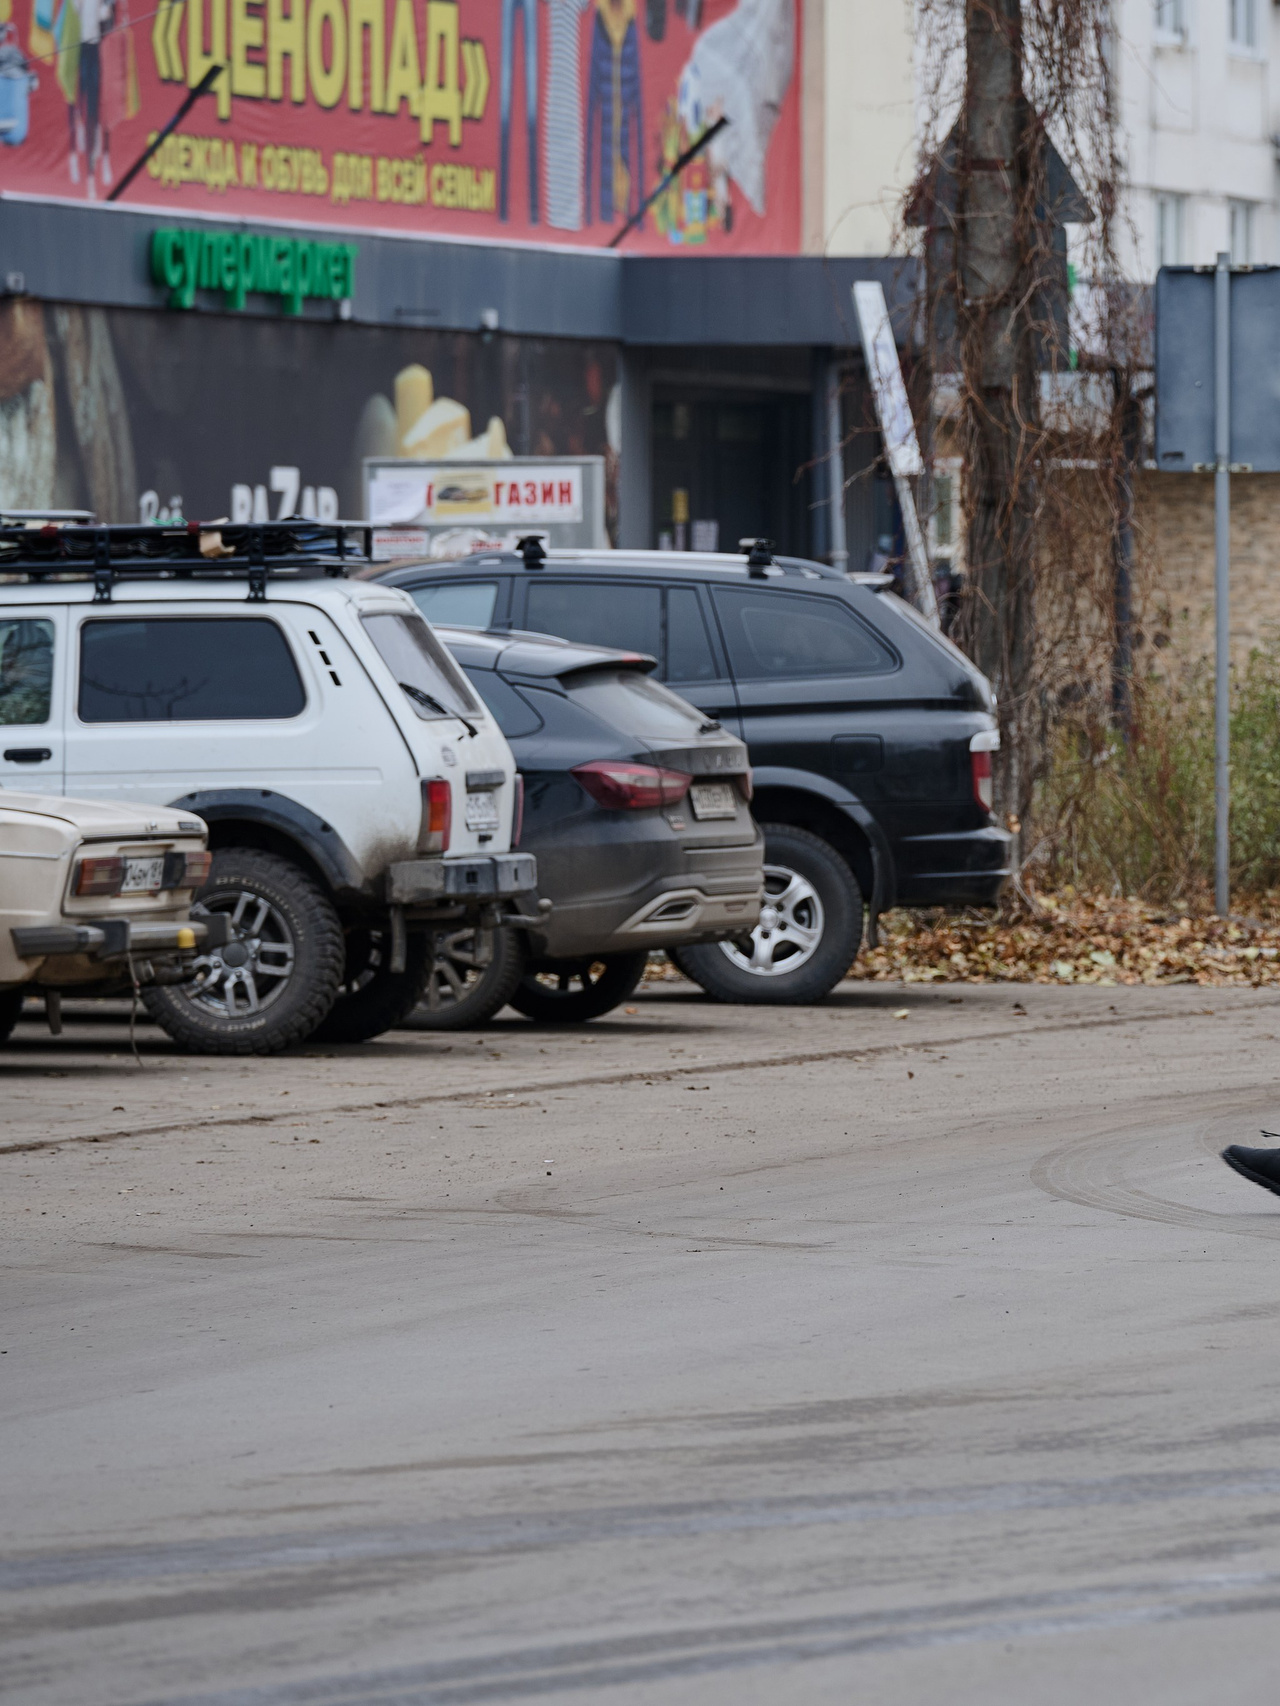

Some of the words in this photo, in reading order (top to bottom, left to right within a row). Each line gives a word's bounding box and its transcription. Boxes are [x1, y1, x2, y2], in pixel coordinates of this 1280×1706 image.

[152, 0, 490, 147] «ЦЕНОПАД»
[147, 131, 238, 193] ОДЕЖДА
[242, 142, 257, 188] И
[262, 144, 328, 196] ОБУВЬ
[332, 152, 373, 205] ДЛЯ
[377, 152, 427, 206] ВСЕЙ
[431, 163, 495, 213] СЕМЬИ
[153, 227, 359, 316] супермаркет
